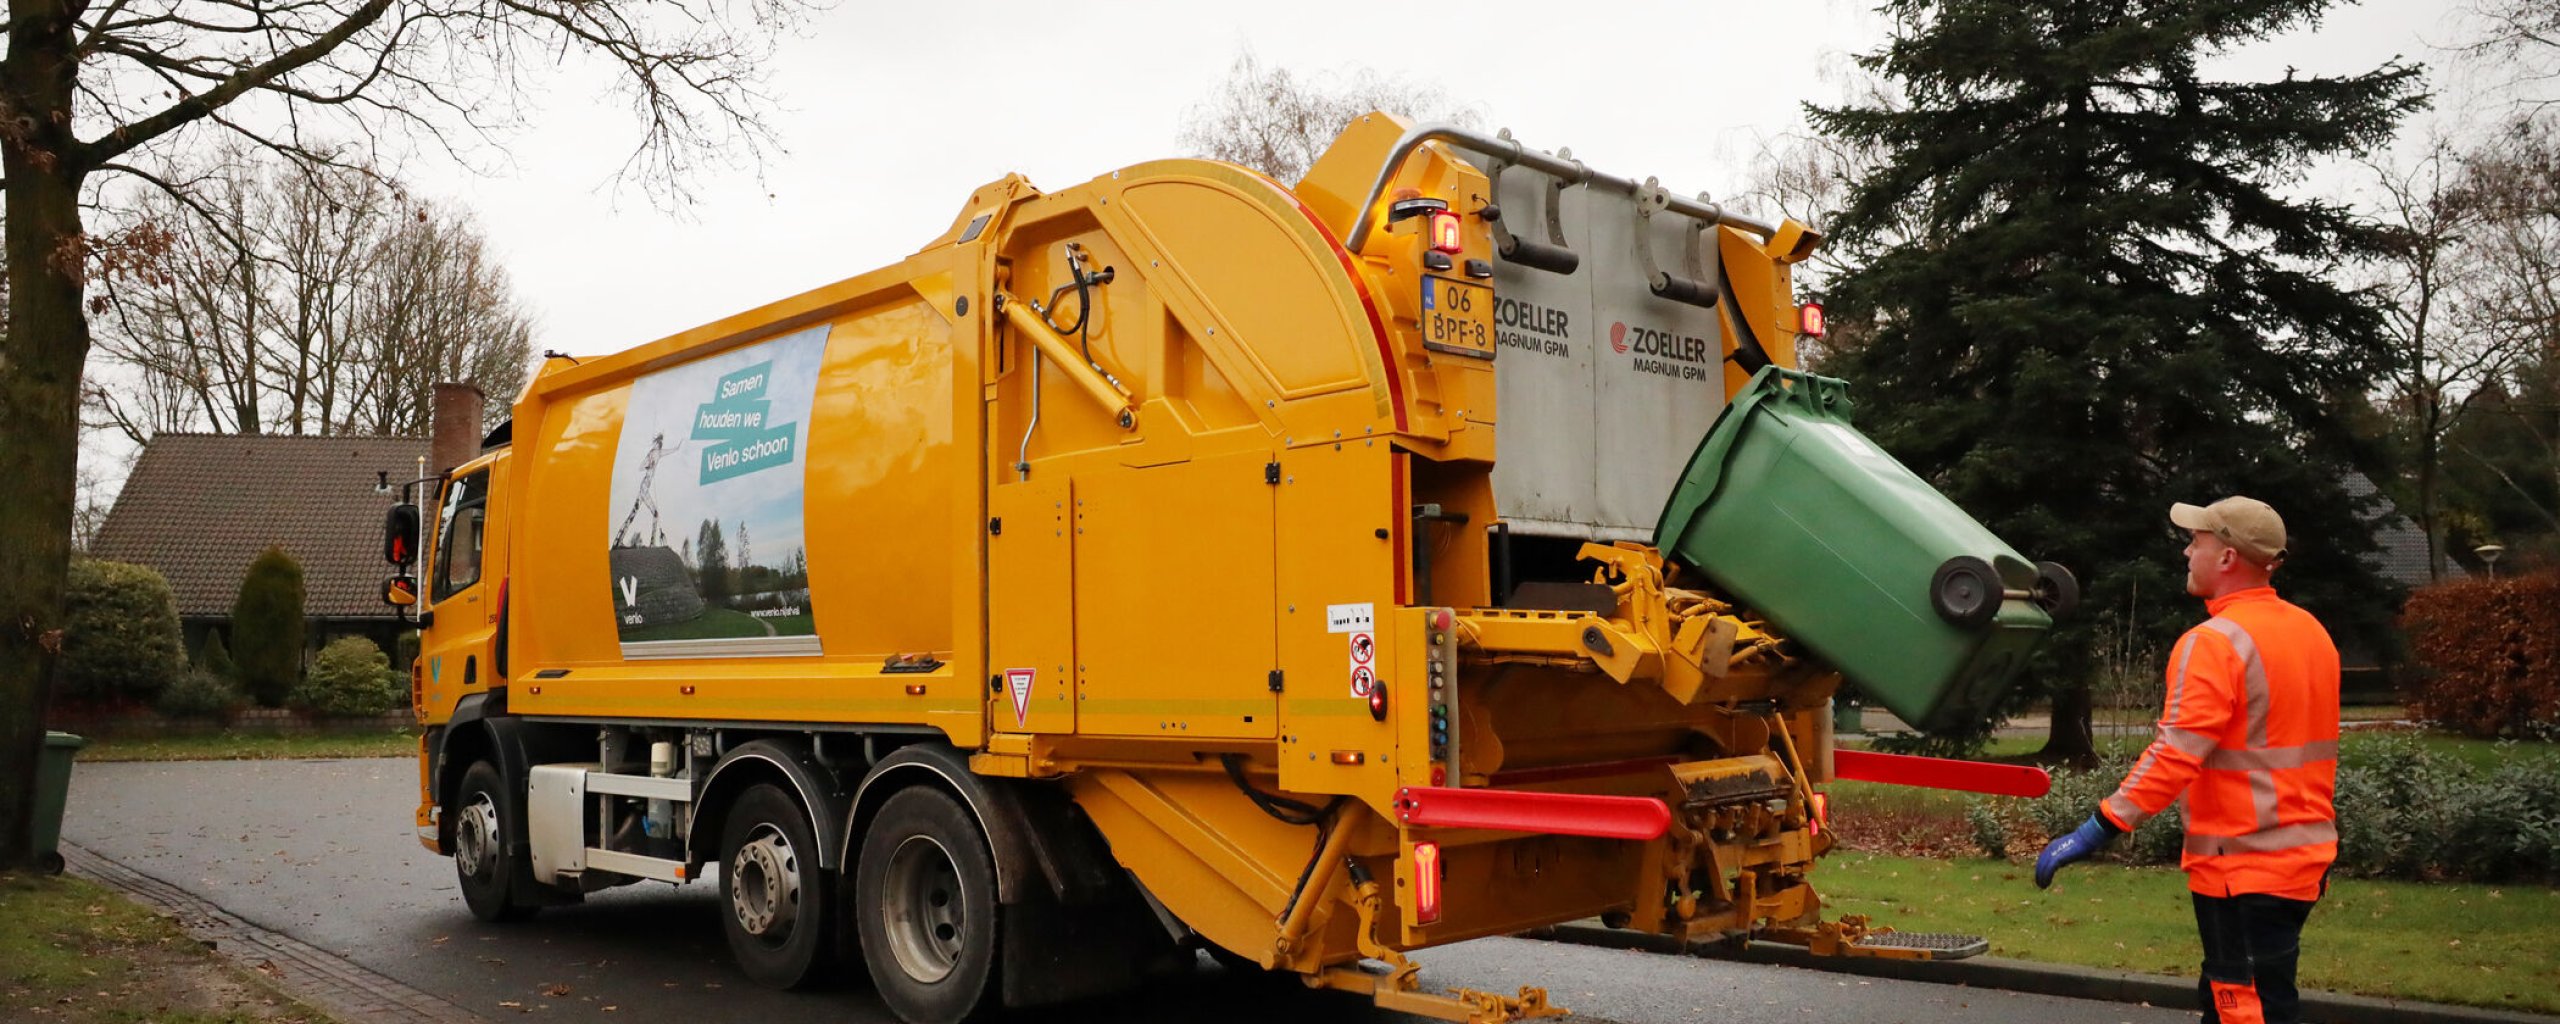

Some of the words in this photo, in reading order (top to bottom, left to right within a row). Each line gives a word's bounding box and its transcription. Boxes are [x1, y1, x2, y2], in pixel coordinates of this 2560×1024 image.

[1447, 286, 1471, 313] 06
[1434, 314, 1486, 347] BPF-8
[1544, 339, 1569, 359] GPM
[1632, 325, 1706, 364] ZOELLER
[1633, 357, 1681, 379] MAGNUM
[1682, 366, 1707, 382] GPM
[721, 374, 763, 399] Samen
[699, 409, 741, 429] houden
[743, 411, 761, 427] we
[707, 447, 739, 472] Venlo
[741, 436, 788, 463] schoon
